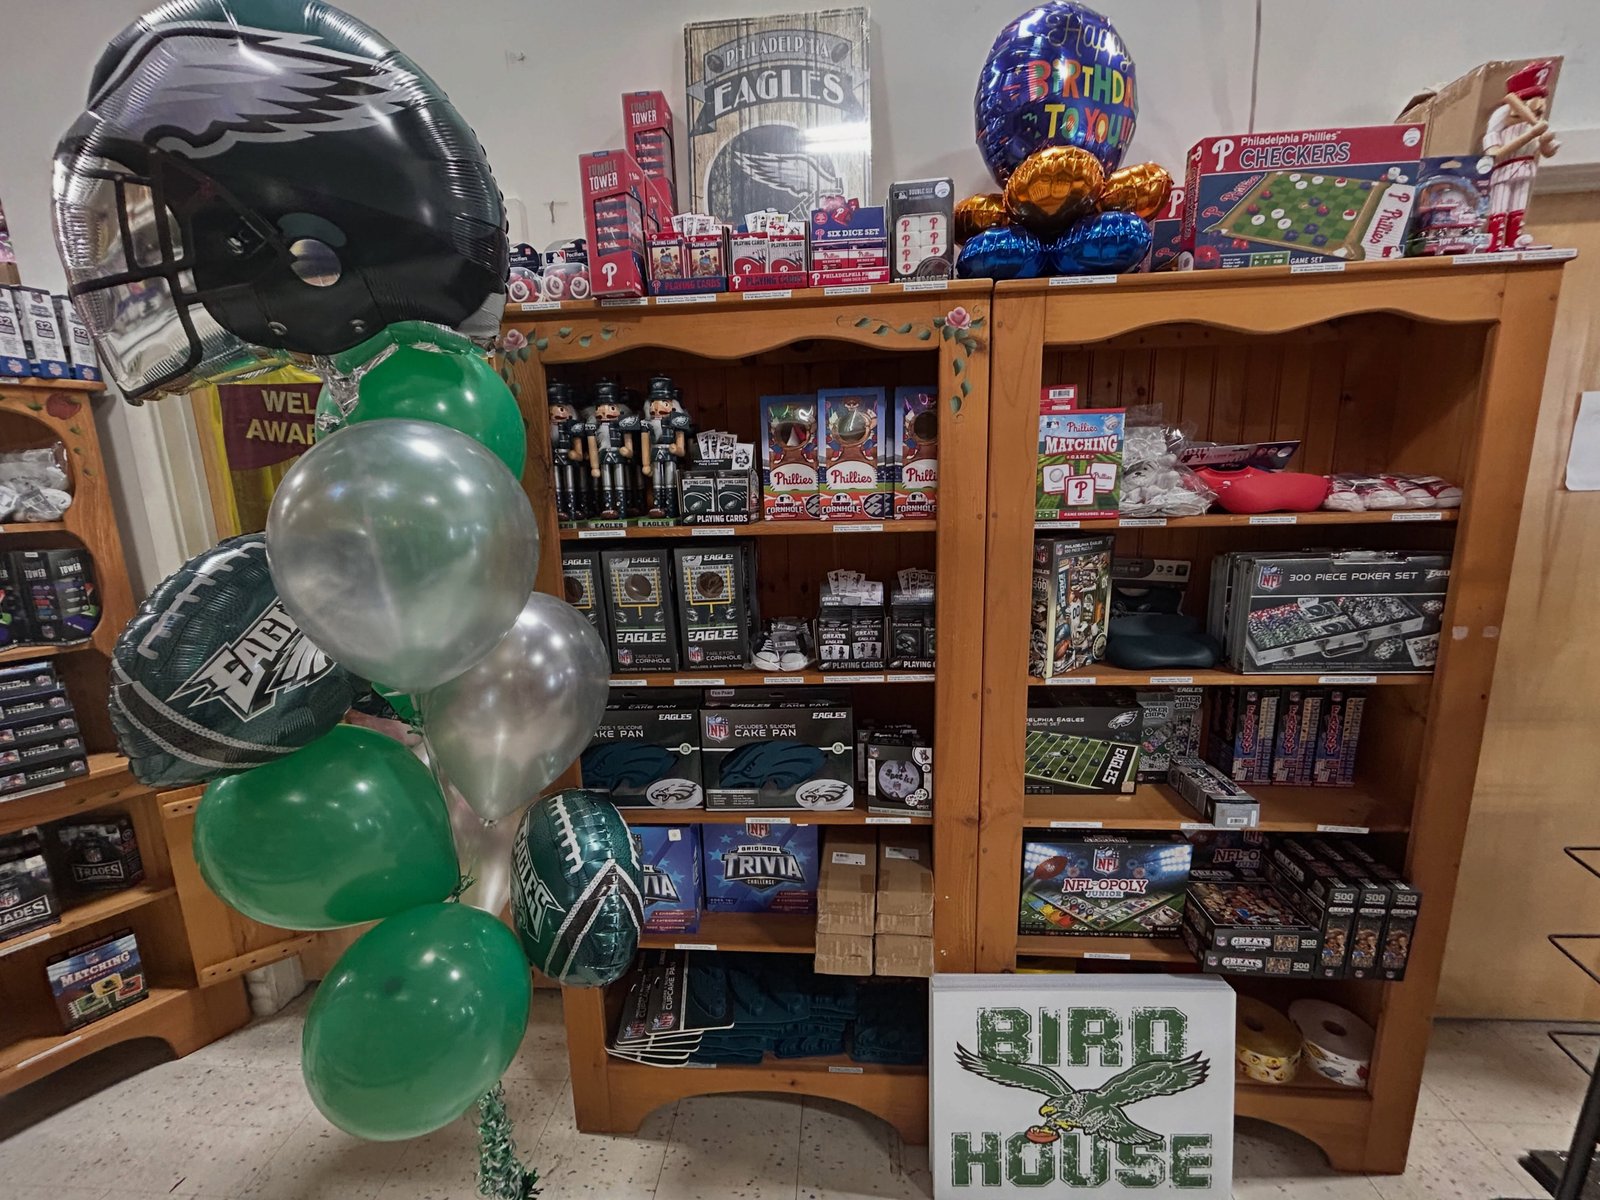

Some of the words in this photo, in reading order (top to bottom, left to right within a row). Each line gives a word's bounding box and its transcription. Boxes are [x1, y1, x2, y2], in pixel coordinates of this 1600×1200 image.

[1046, 11, 1134, 72] Happy
[726, 35, 830, 67] PHILADELPHIA
[1027, 60, 1136, 111] BIRTHDA
[713, 69, 845, 117] EAGLES
[632, 109, 657, 125] TOWER
[1044, 104, 1080, 140] TO
[1240, 132, 1300, 147] Philadelphia
[1240, 142, 1351, 170] CHECKERS
[589, 172, 618, 191] TOWER
[827, 230, 842, 238] SIX
[842, 229, 864, 237] DICE
[865, 228, 880, 236] SET
[1369, 208, 1404, 245] Phillies
[1290, 256, 1310, 265] GAME
[1311, 255, 1324, 264] SET
[822, 271, 861, 279] PHILADELPHIA
[261, 389, 316, 415] WEL
[1066, 421, 1098, 433] Phillies
[1045, 434, 1118, 455] MATCHING
[773, 471, 814, 486] Phillies
[830, 470, 872, 484] Phillies
[906, 467, 937, 482] Philli
[766, 505, 804, 515] CORNHOLE
[821, 504, 862, 514] CORNHOLE
[896, 504, 937, 514] CORNHOLE
[697, 514, 725, 523] PLAYING
[725, 514, 748, 522] CARDS
[24, 568, 47, 579] TOWER
[60, 562, 82, 575] TOWER
[1289, 573, 1312, 582] 300
[1315, 573, 1347, 581] PIECE
[1351, 572, 1391, 580] POKER
[1394, 571, 1419, 580] SET
[832, 661, 860, 669] PLAYING
[903, 660, 931, 668] PLAYING
[658, 713, 692, 721] EAGLES
[812, 711, 847, 719] EAGLES
[620, 730, 644, 738] PAN
[734, 729, 766, 737] CAKE
[772, 729, 797, 737] PAN
[1101, 747, 1128, 785] EAGLES
[77, 863, 120, 878] TRADES
[724, 853, 803, 878] TRIVIA
[1086, 890, 1124, 898] JUNIOR
[1334, 892, 1355, 900] 500
[1365, 893, 1386, 902] 500
[1397, 894, 1418, 903] 500
[0, 900, 46, 927] RADES
[1230, 936, 1272, 948] GREATS
[1300, 939, 1318, 947] 500
[60, 950, 131, 988] MATCHING
[1221, 956, 1263, 969] GREATS
[1293, 962, 1310, 970] 500
[665, 977, 675, 1011] CUPCAKE
[976, 1006, 1188, 1067] BIRD
[951, 1131, 1213, 1189] HOUSE
